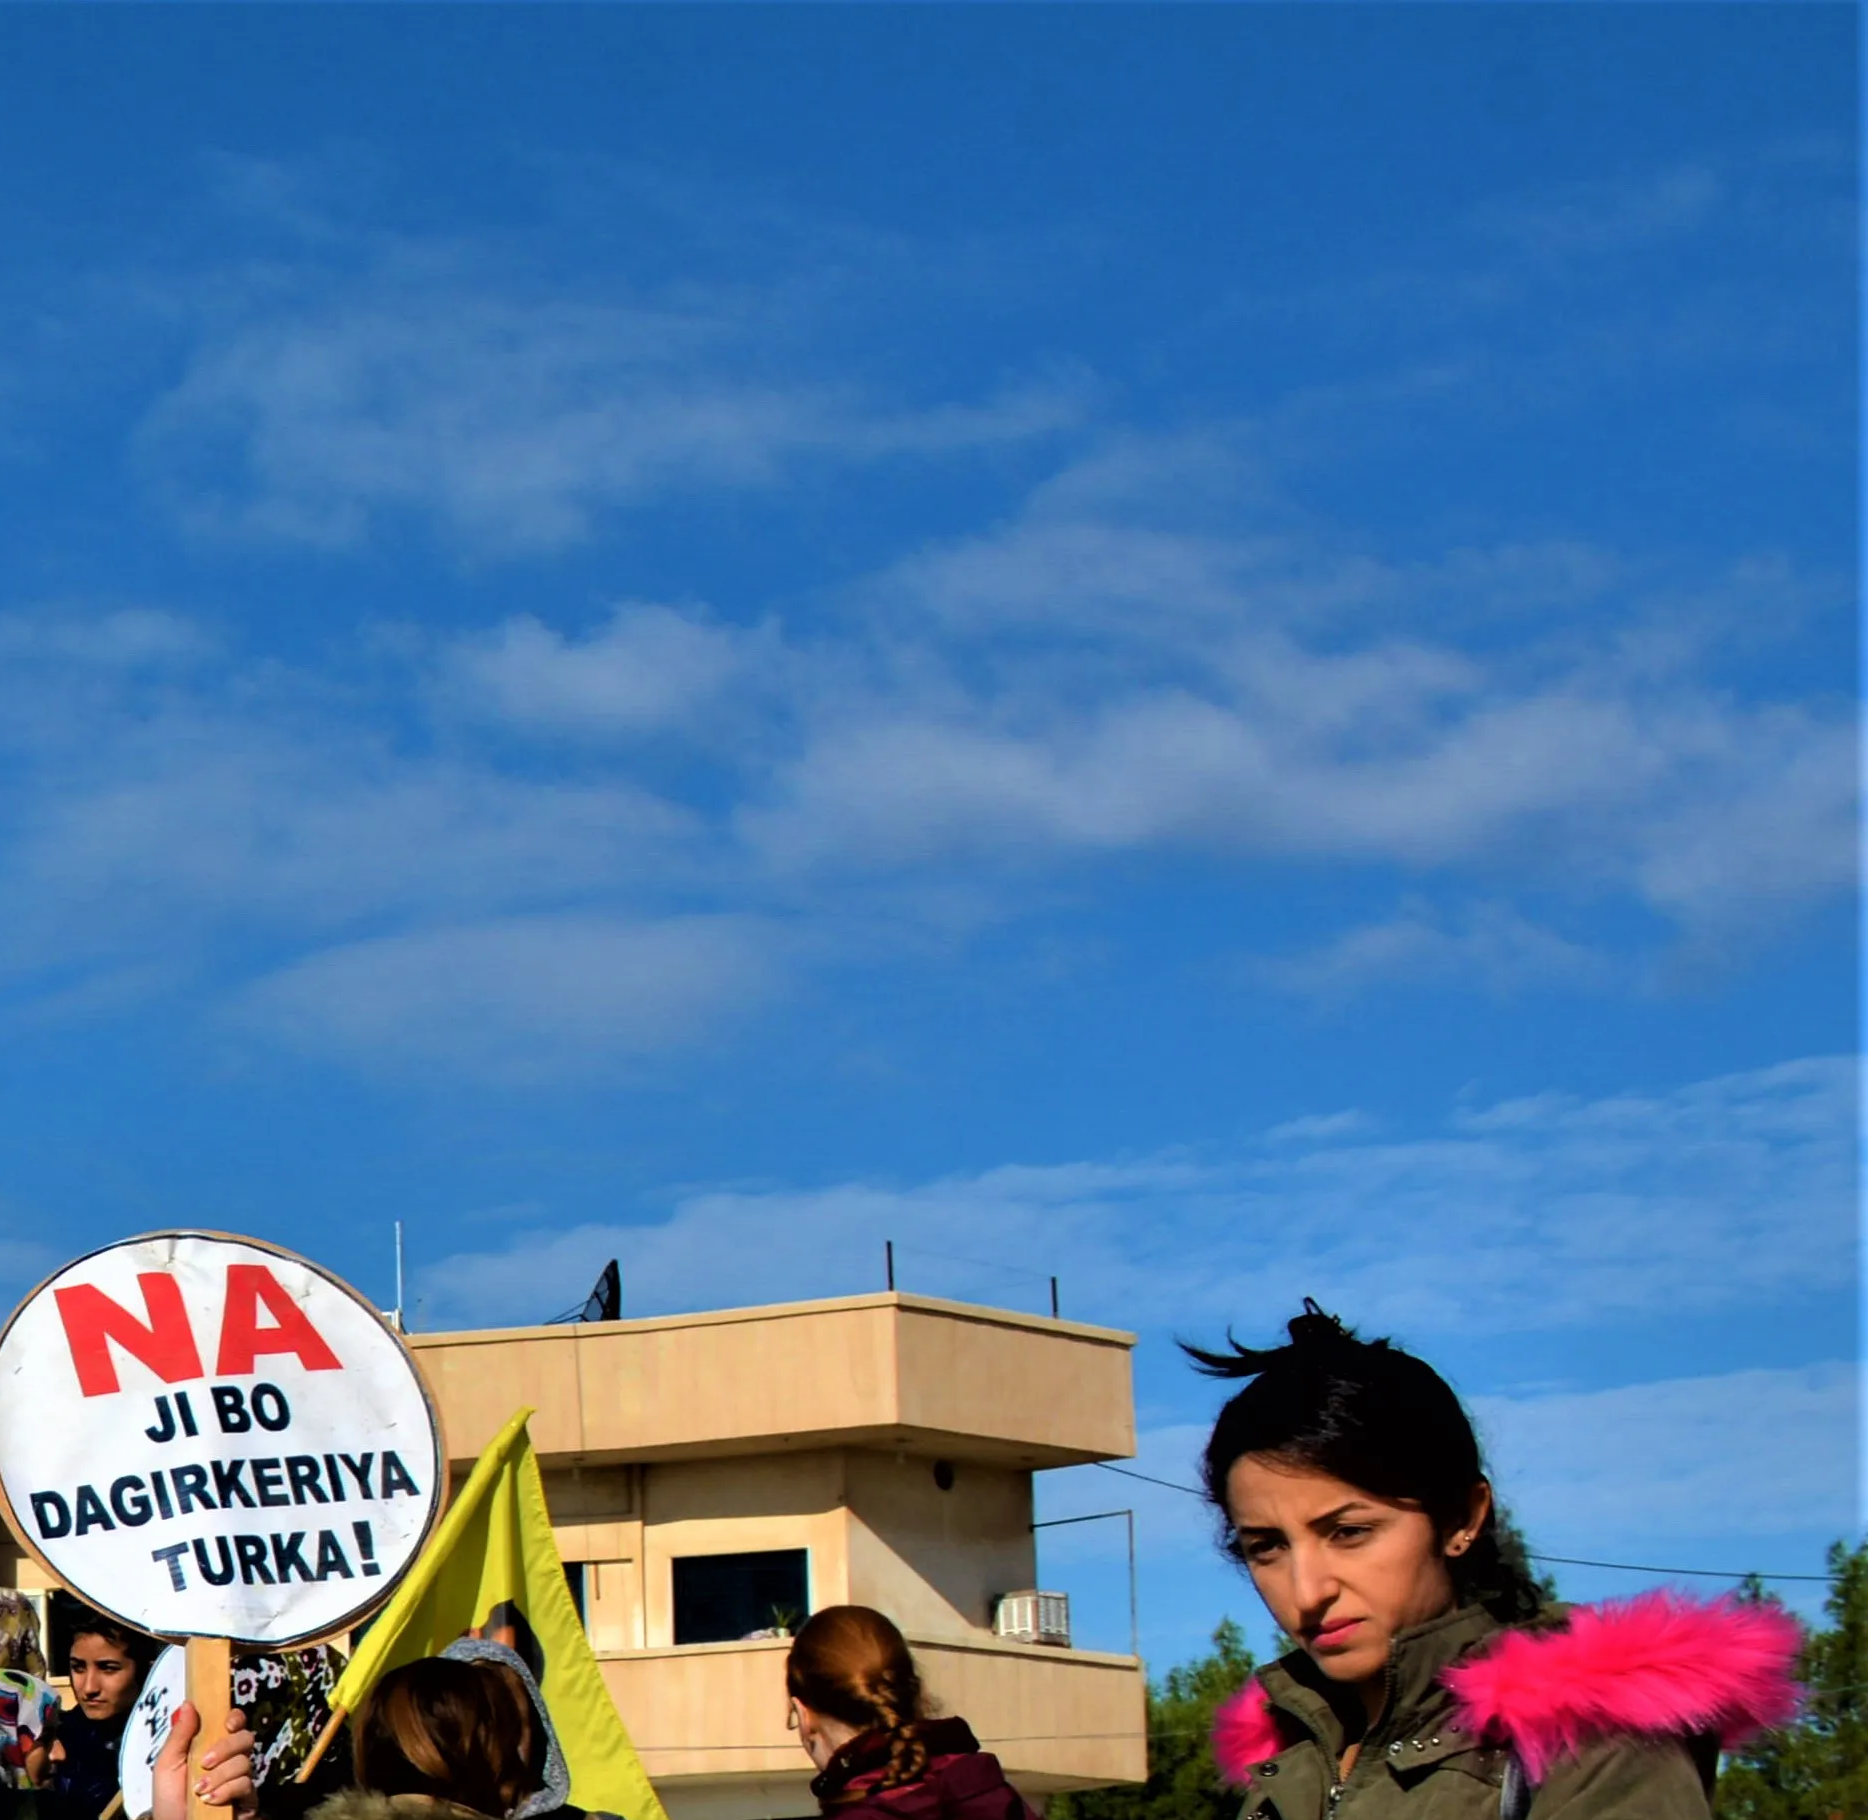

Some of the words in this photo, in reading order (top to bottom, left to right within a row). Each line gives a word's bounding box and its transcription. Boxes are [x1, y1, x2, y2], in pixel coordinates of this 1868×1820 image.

[54, 1264, 343, 1397] NA
[145, 1392, 198, 1443] JI
[210, 1383, 290, 1433] BO
[31, 1453, 420, 1541] DAGIRKERIYA
[152, 1518, 382, 1592] TURKA!
